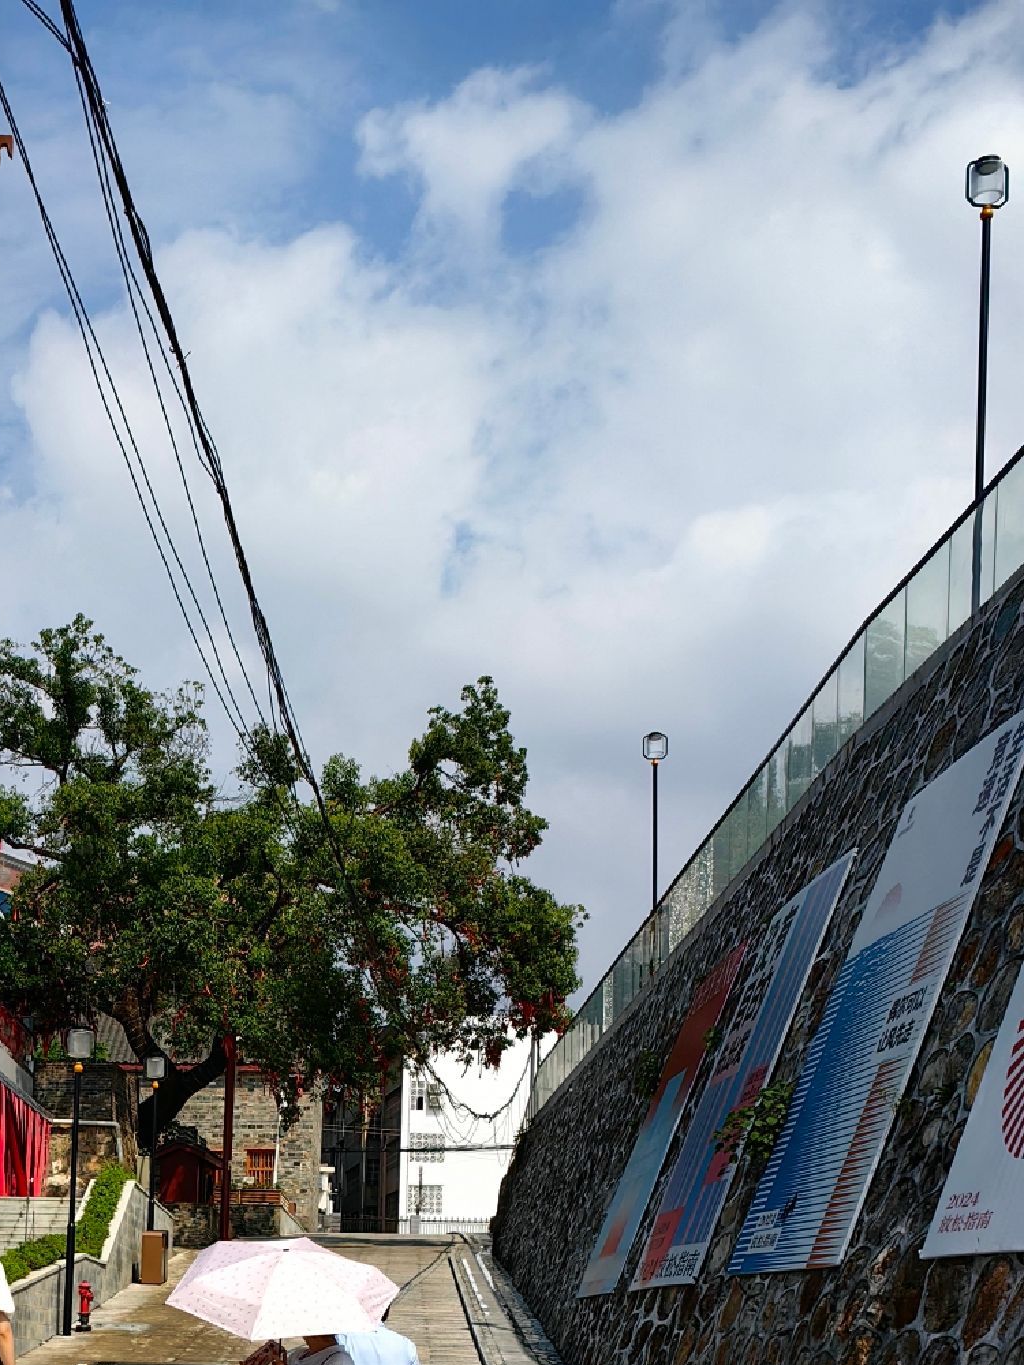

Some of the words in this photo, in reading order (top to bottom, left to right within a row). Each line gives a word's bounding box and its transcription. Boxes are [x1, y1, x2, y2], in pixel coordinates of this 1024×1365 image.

[946, 1192, 980, 1209] 2024
[938, 1209, 994, 1234] 放松指南
